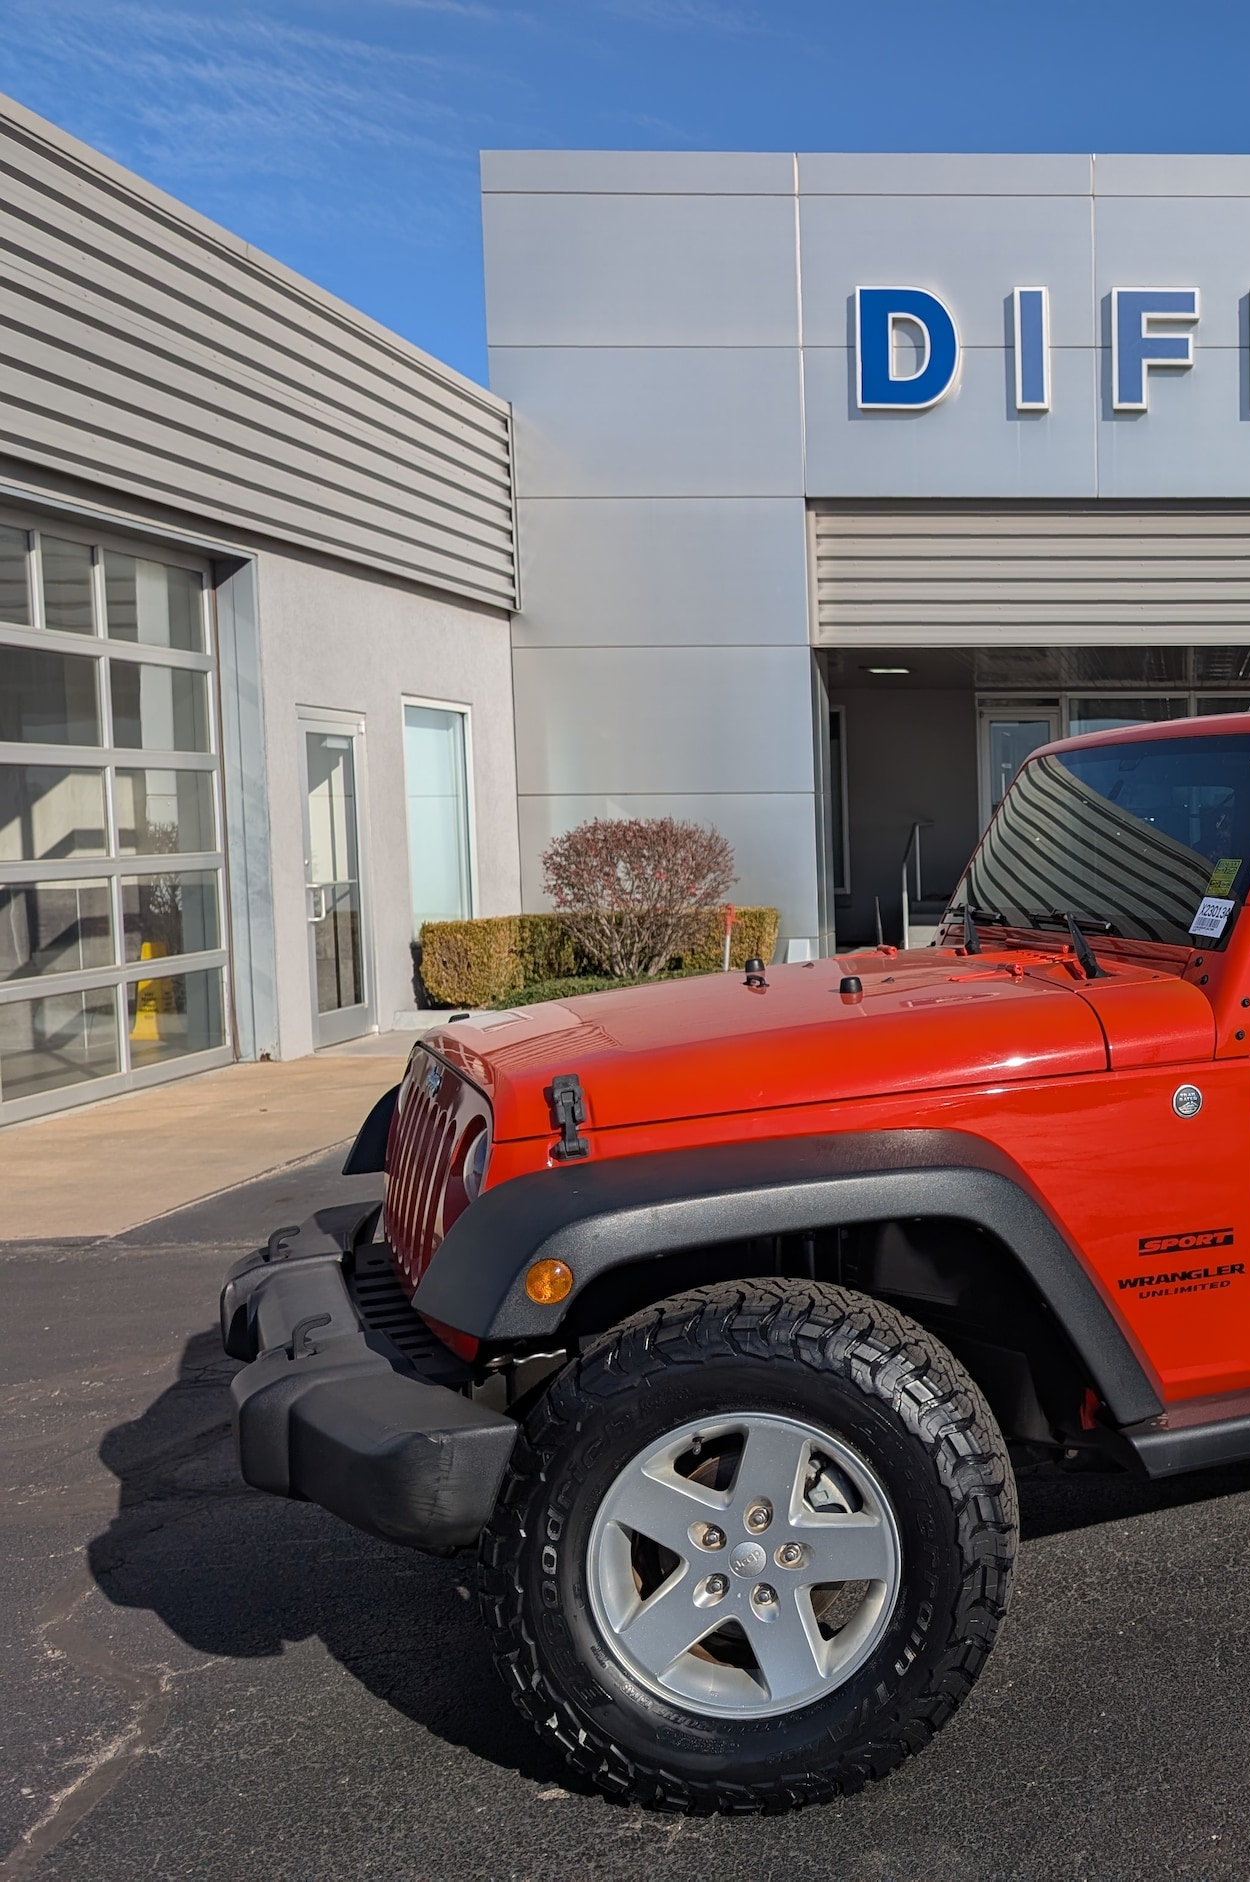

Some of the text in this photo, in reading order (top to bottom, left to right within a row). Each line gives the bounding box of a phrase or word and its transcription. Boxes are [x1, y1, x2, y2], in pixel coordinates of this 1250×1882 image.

[1139, 1231, 1234, 1254] SPORT
[1117, 1262, 1246, 1290] WRANGLER
[1138, 1280, 1232, 1299] UNLIMITED
[735, 1550, 760, 1571] Jeep
